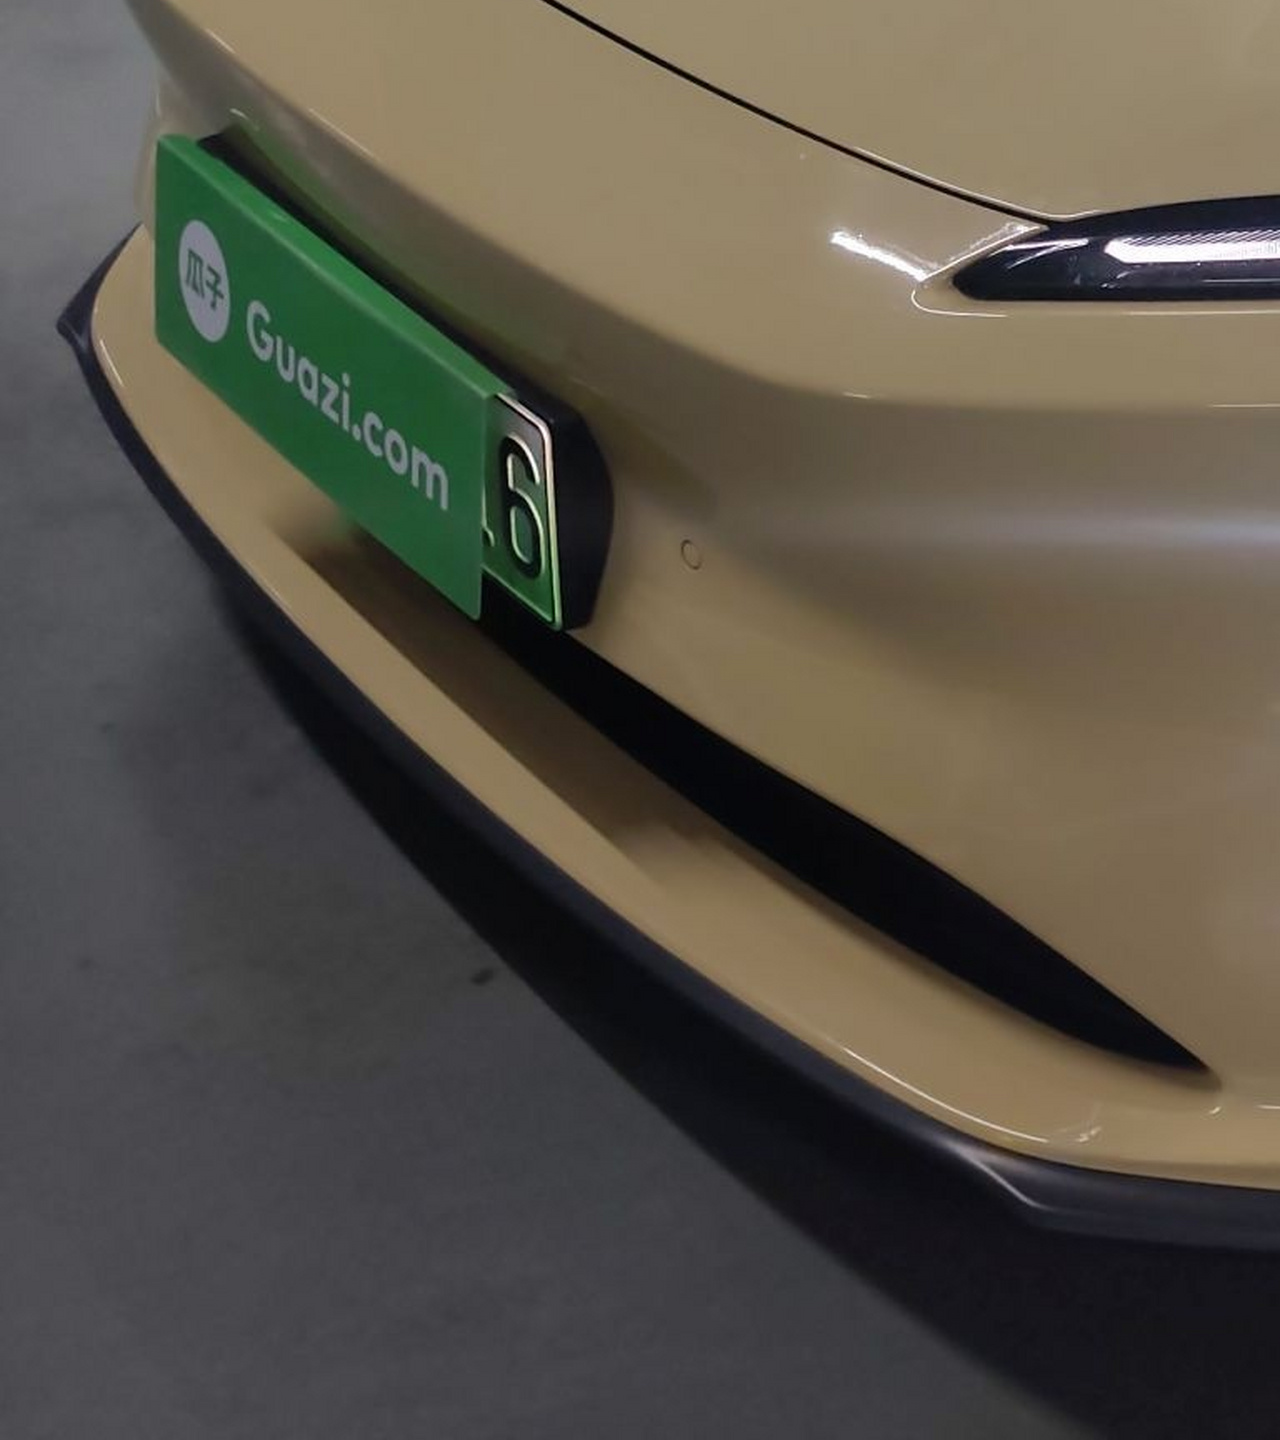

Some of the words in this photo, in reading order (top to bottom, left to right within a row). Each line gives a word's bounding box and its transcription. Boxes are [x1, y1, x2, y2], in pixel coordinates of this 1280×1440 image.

[185, 247, 227, 311] 瓜子
[245, 299, 451, 513] Guazi.com
[484, 430, 546, 580] 6
